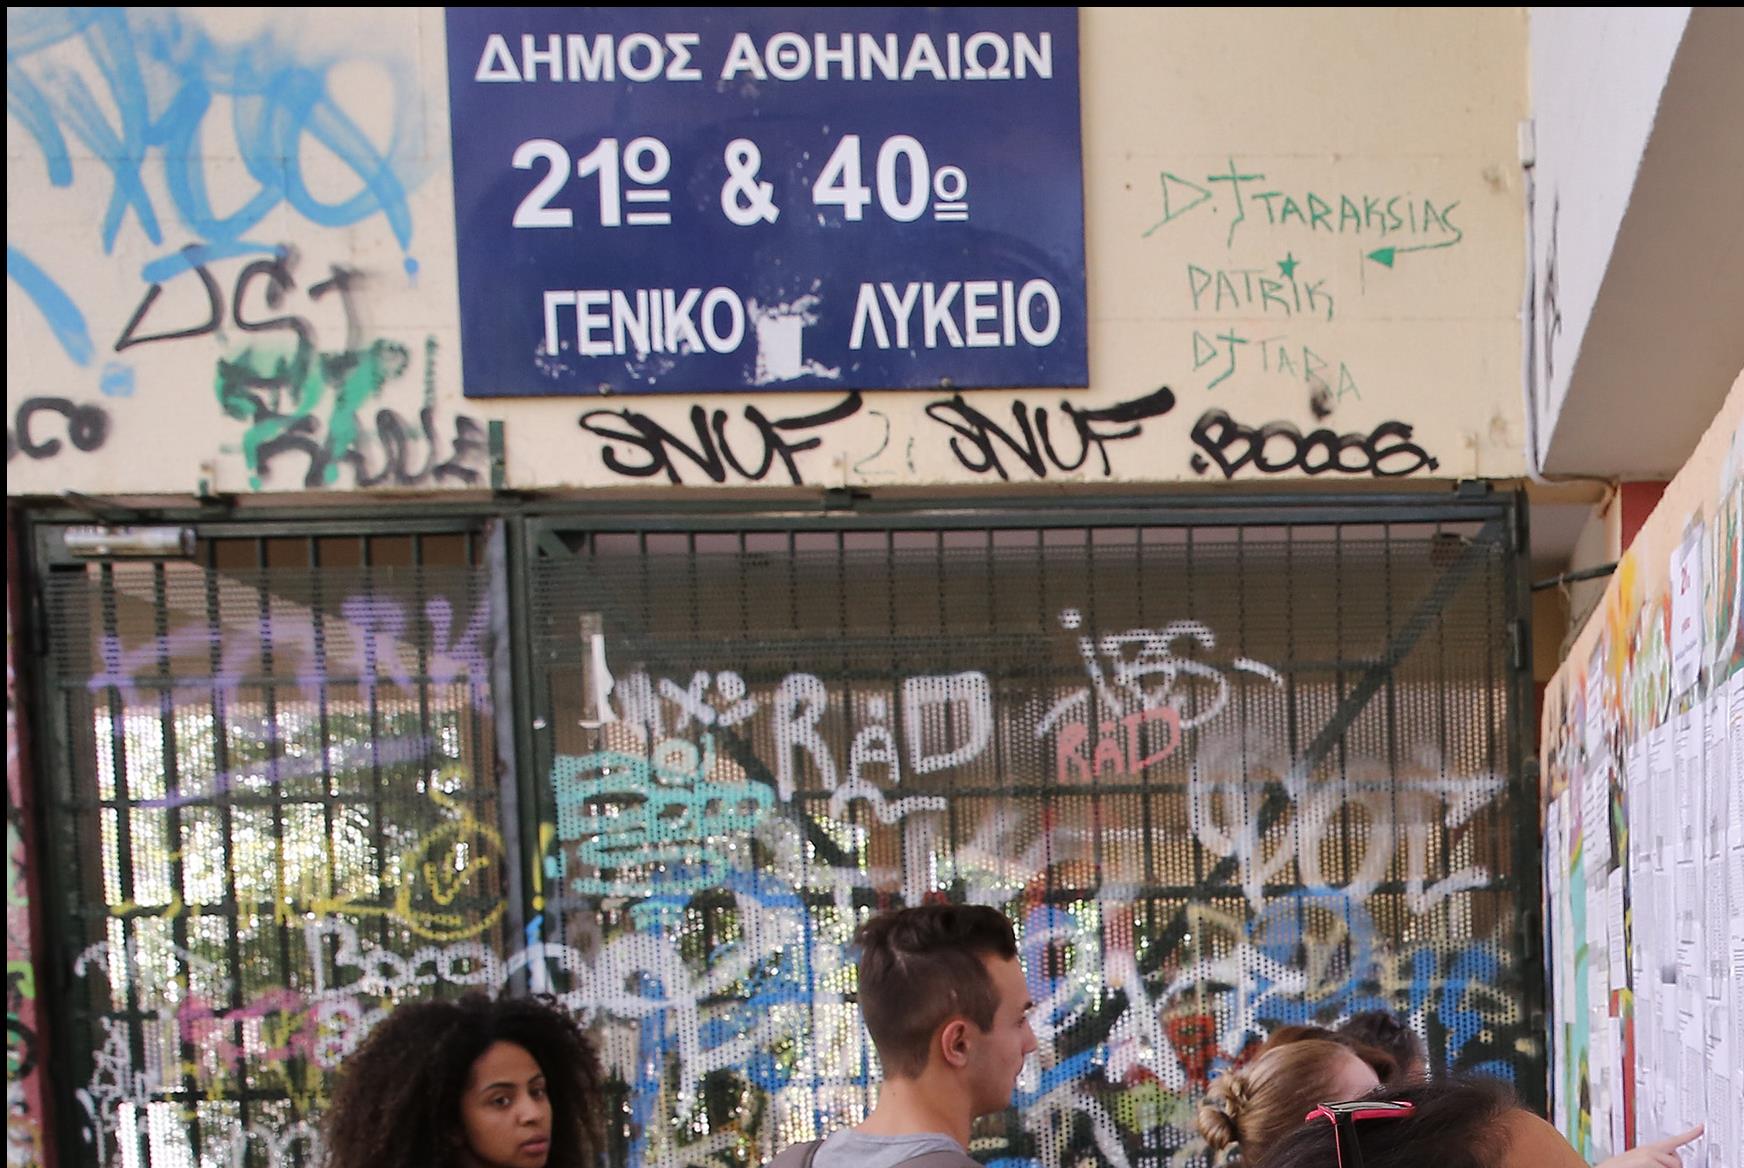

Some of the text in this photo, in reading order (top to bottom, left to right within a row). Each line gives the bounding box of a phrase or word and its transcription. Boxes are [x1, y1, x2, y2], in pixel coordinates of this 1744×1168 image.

[474, 31, 1055, 83] ΔΗΜΟΣ ΑΘΗΝΑΙΩΝ
[719, 138, 781, 227] &
[542, 278, 1062, 358] ΓΕΝΙΚΟ ΛΥΚΕΙΟ
